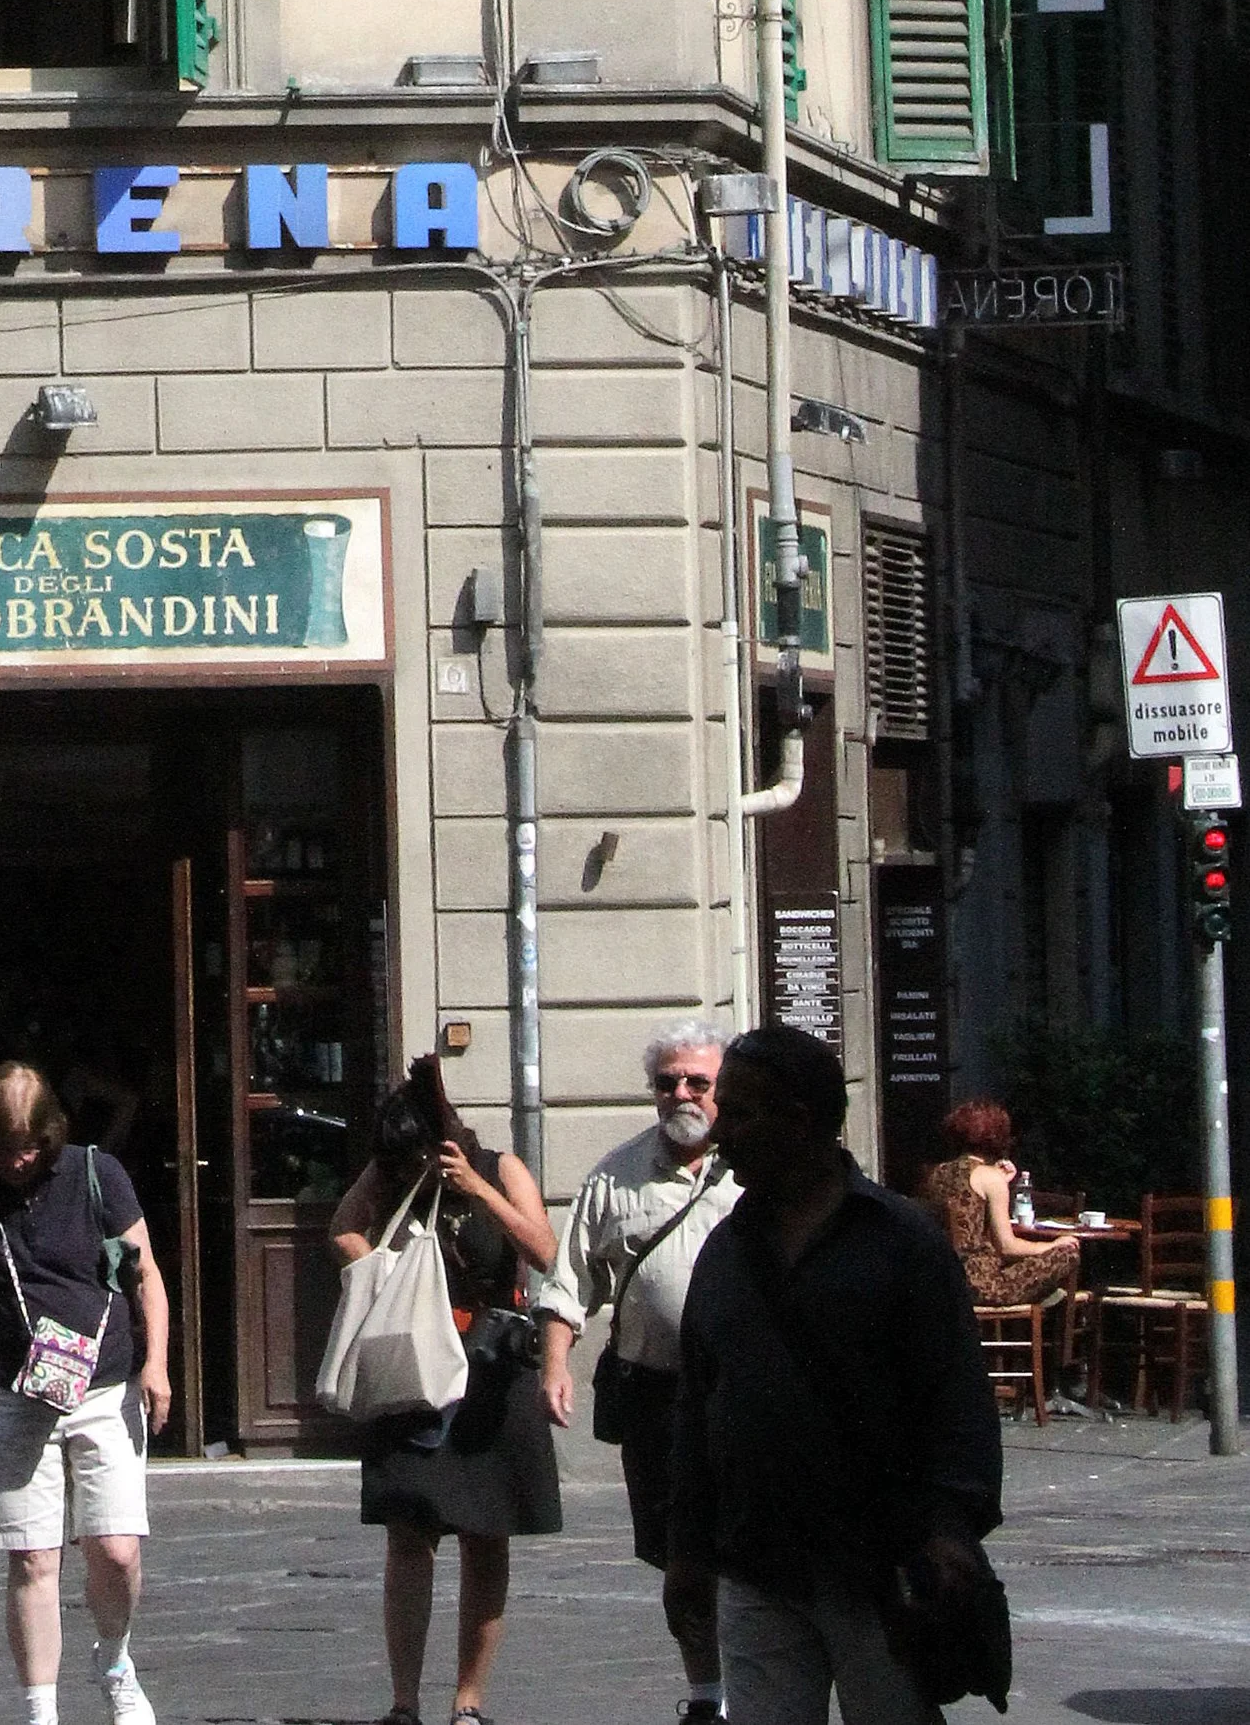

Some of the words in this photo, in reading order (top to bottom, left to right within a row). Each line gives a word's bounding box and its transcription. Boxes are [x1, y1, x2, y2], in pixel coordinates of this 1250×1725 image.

[83, 527, 256, 570] SOSTA
[13, 575, 113, 595] DEGLI
[1134, 702, 1222, 720] dissuasore
[1153, 723, 1208, 743] mobile
[774, 909, 835, 919] SANDWICHES
[779, 925, 831, 934] BOCCACCIO
[781, 942, 830, 950] BOTTICELLI
[792, 999, 822, 1007] DANTE
[781, 1015, 834, 1023] DONATELLO
